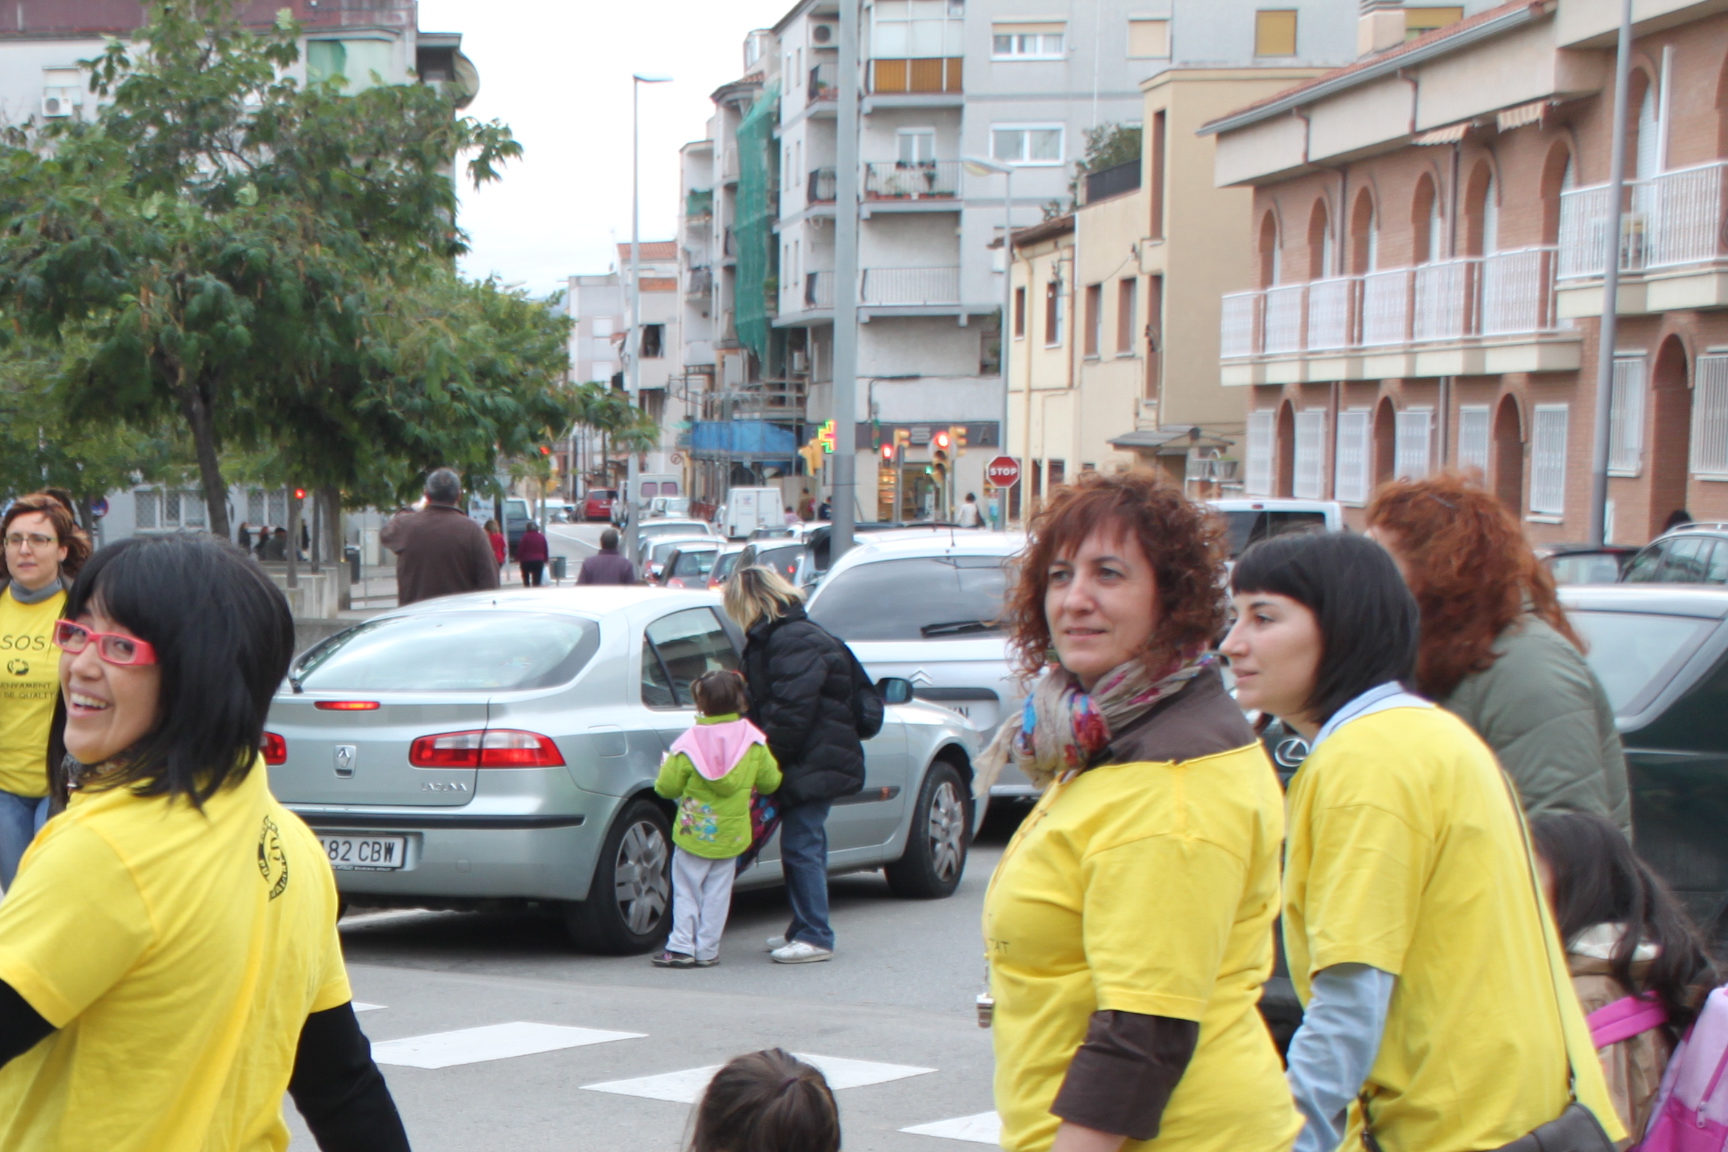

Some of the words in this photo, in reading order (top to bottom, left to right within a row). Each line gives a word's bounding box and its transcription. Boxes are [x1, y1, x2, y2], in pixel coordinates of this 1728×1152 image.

[989, 467, 1017, 476] STOP
[0, 634, 45, 651] SOS
[421, 782, 468, 792] LAGUNA
[321, 839, 352, 862] 82
[358, 841, 395, 863] CBW
